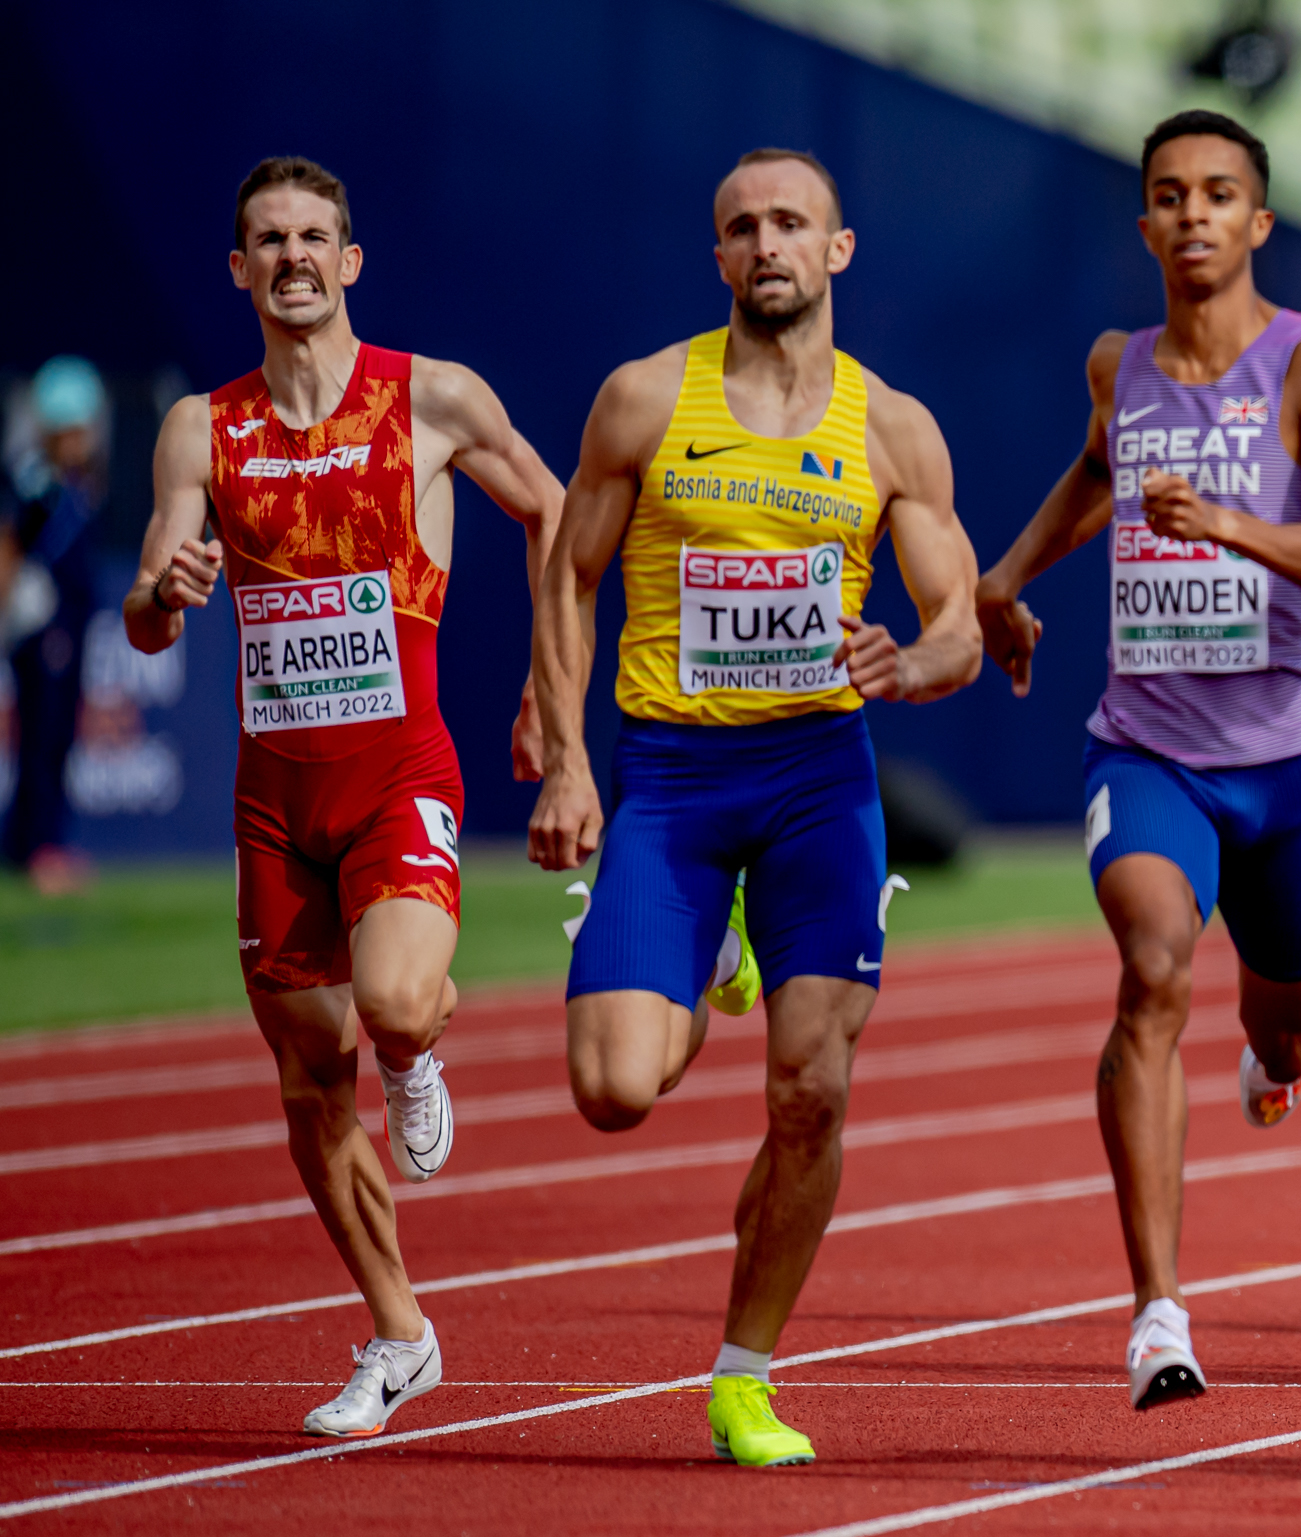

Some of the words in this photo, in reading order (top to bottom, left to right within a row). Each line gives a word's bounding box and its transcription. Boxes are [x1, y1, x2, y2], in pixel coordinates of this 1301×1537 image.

[1116, 426, 1262, 463] GREAT
[240, 445, 372, 478] ESPAÑA
[664, 470, 721, 500] Bosnia
[727, 476, 759, 504] and
[763, 478, 862, 529] Herzegovina
[688, 557, 807, 588] SPAR
[243, 585, 343, 621] SPAR
[1116, 578, 1259, 617] ROWDEN
[701, 602, 826, 642] TUKA
[246, 641, 274, 678] DE
[282, 629, 392, 675] ARRIBA
[728, 651, 760, 665] RUN
[1120, 645, 1196, 667] MUNICH
[1204, 644, 1258, 667] 2022
[280, 683, 309, 698] RUN
[691, 668, 781, 689] MUNICH
[790, 664, 838, 688] 2022
[253, 700, 331, 725] MUNICH
[339, 692, 394, 717] 2022
